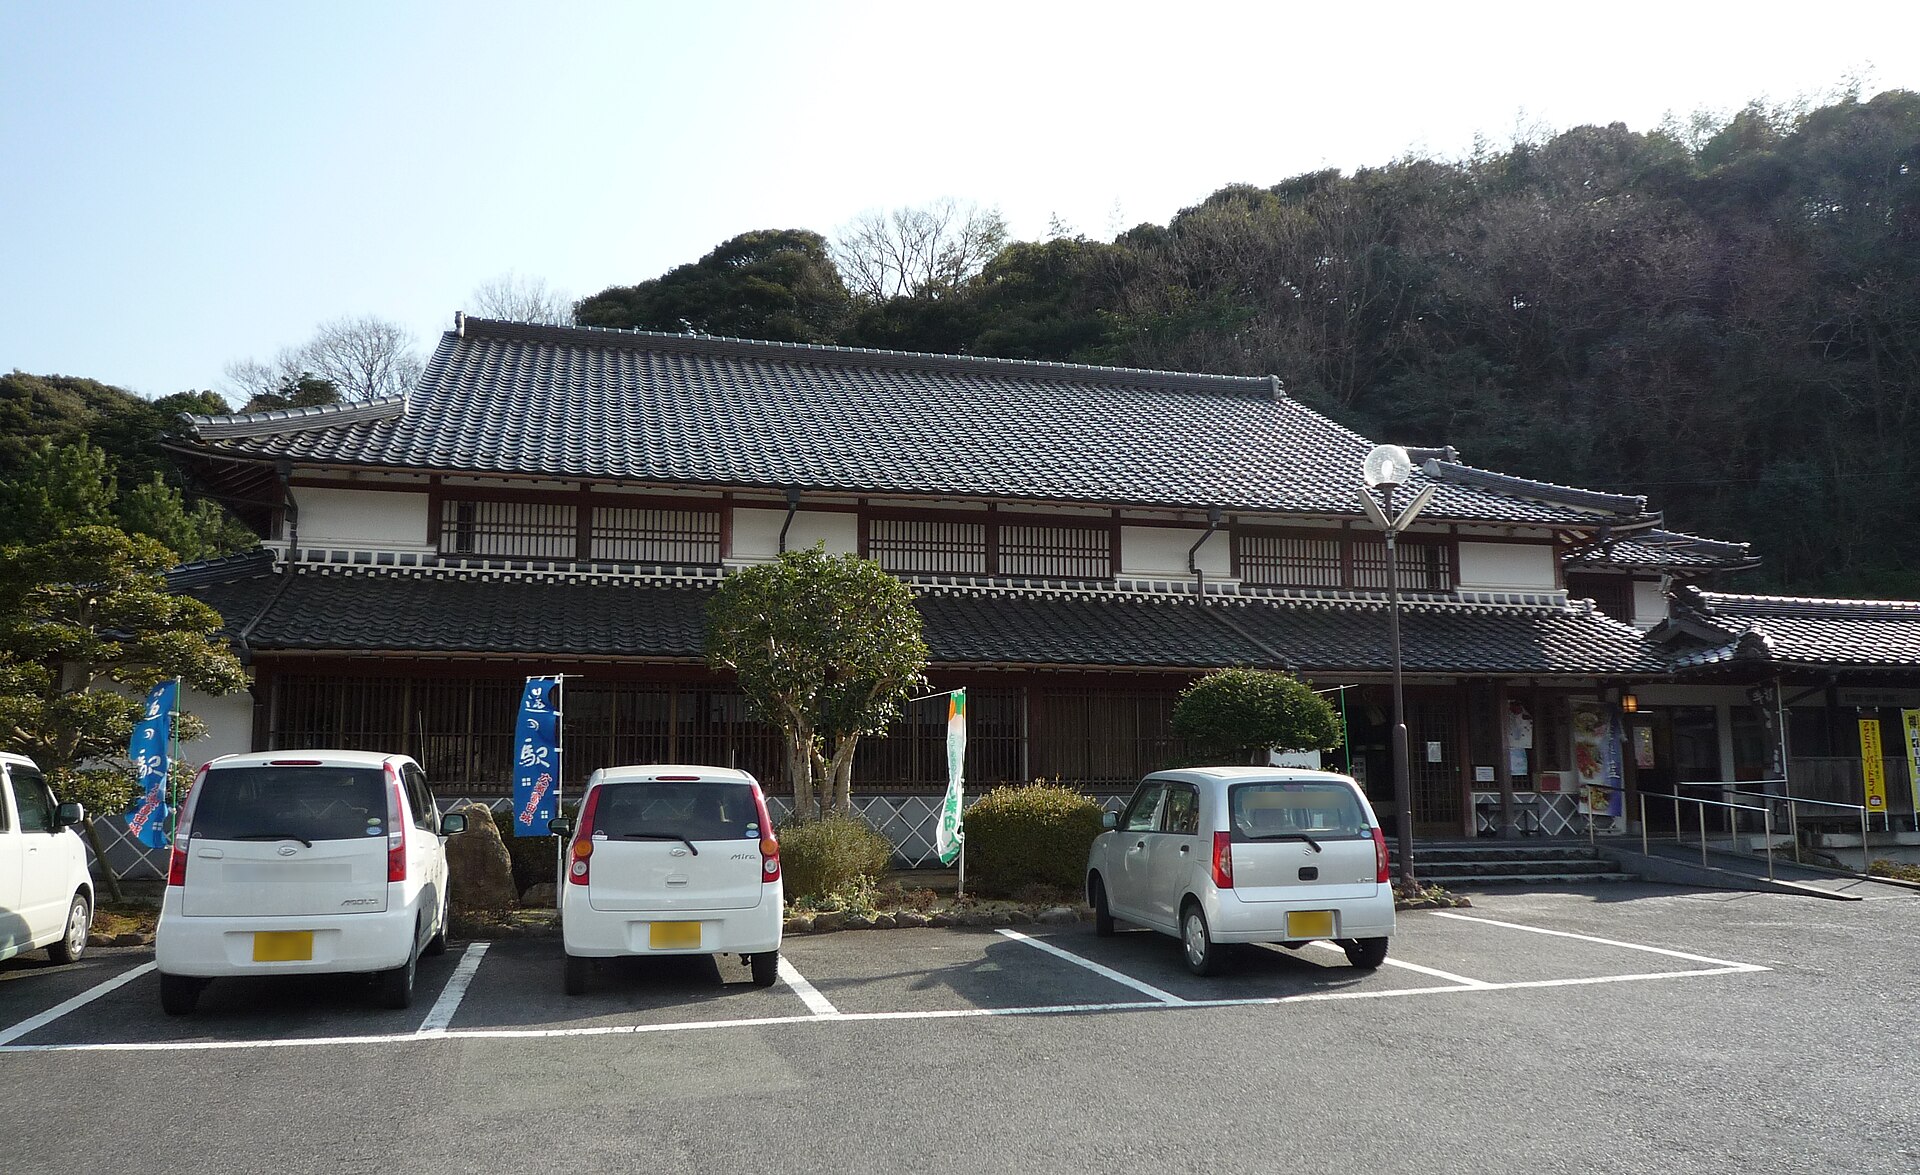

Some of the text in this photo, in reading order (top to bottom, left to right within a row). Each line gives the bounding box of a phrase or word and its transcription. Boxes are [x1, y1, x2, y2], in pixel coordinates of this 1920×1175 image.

[519, 687, 551, 768] 道の駅
[730, 853, 757, 861] Mira
